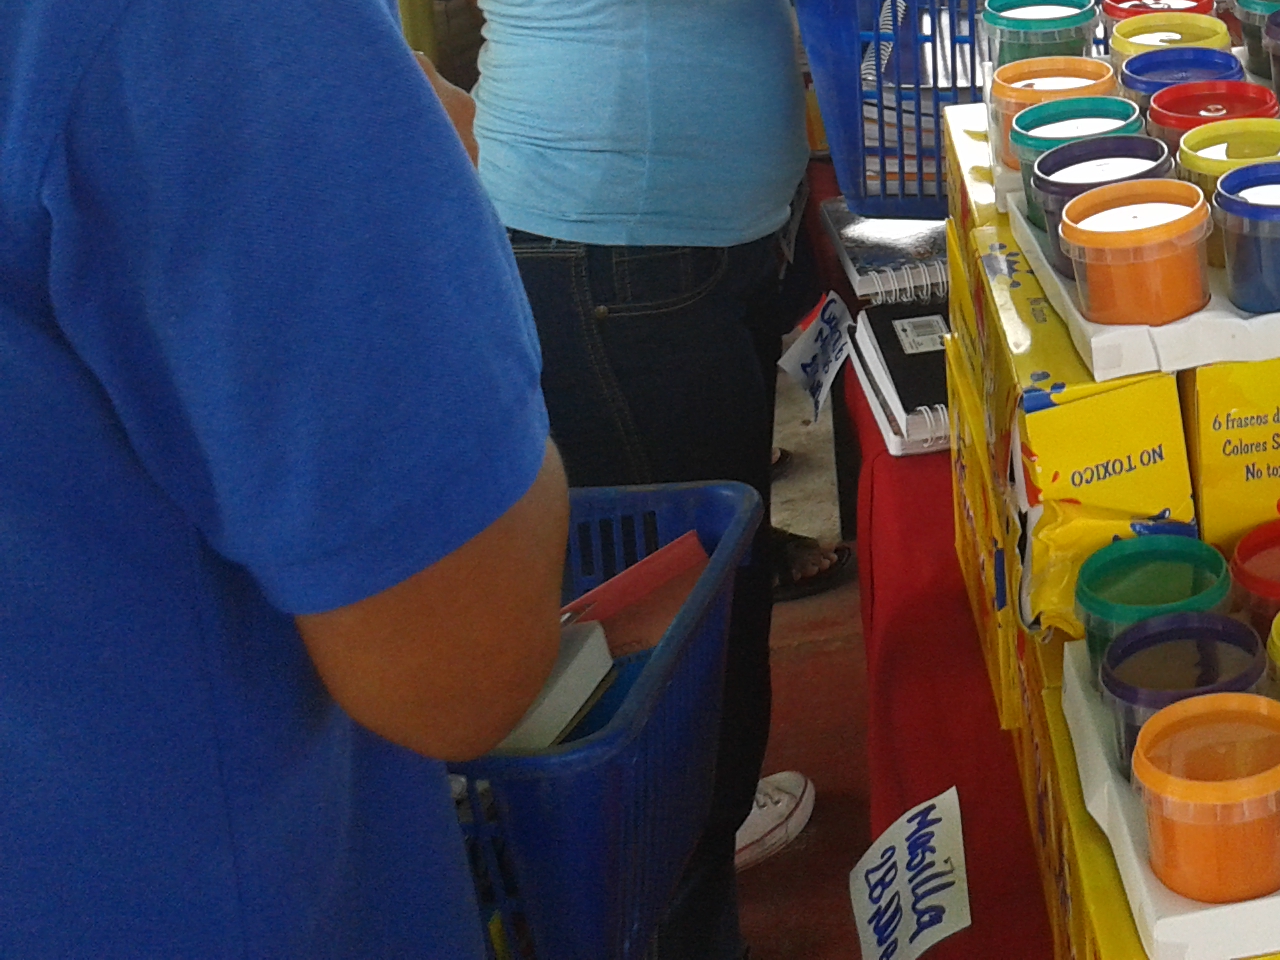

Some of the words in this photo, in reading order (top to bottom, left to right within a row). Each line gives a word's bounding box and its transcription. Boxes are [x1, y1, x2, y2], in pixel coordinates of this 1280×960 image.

[1212, 414, 1222, 432] 6
[1225, 412, 1269, 431] frascos
[1139, 444, 1165, 466] NO
[1222, 439, 1268, 457] Colores
[1070, 454, 1137, 488] TOXICO
[1245, 463, 1263, 482] No
